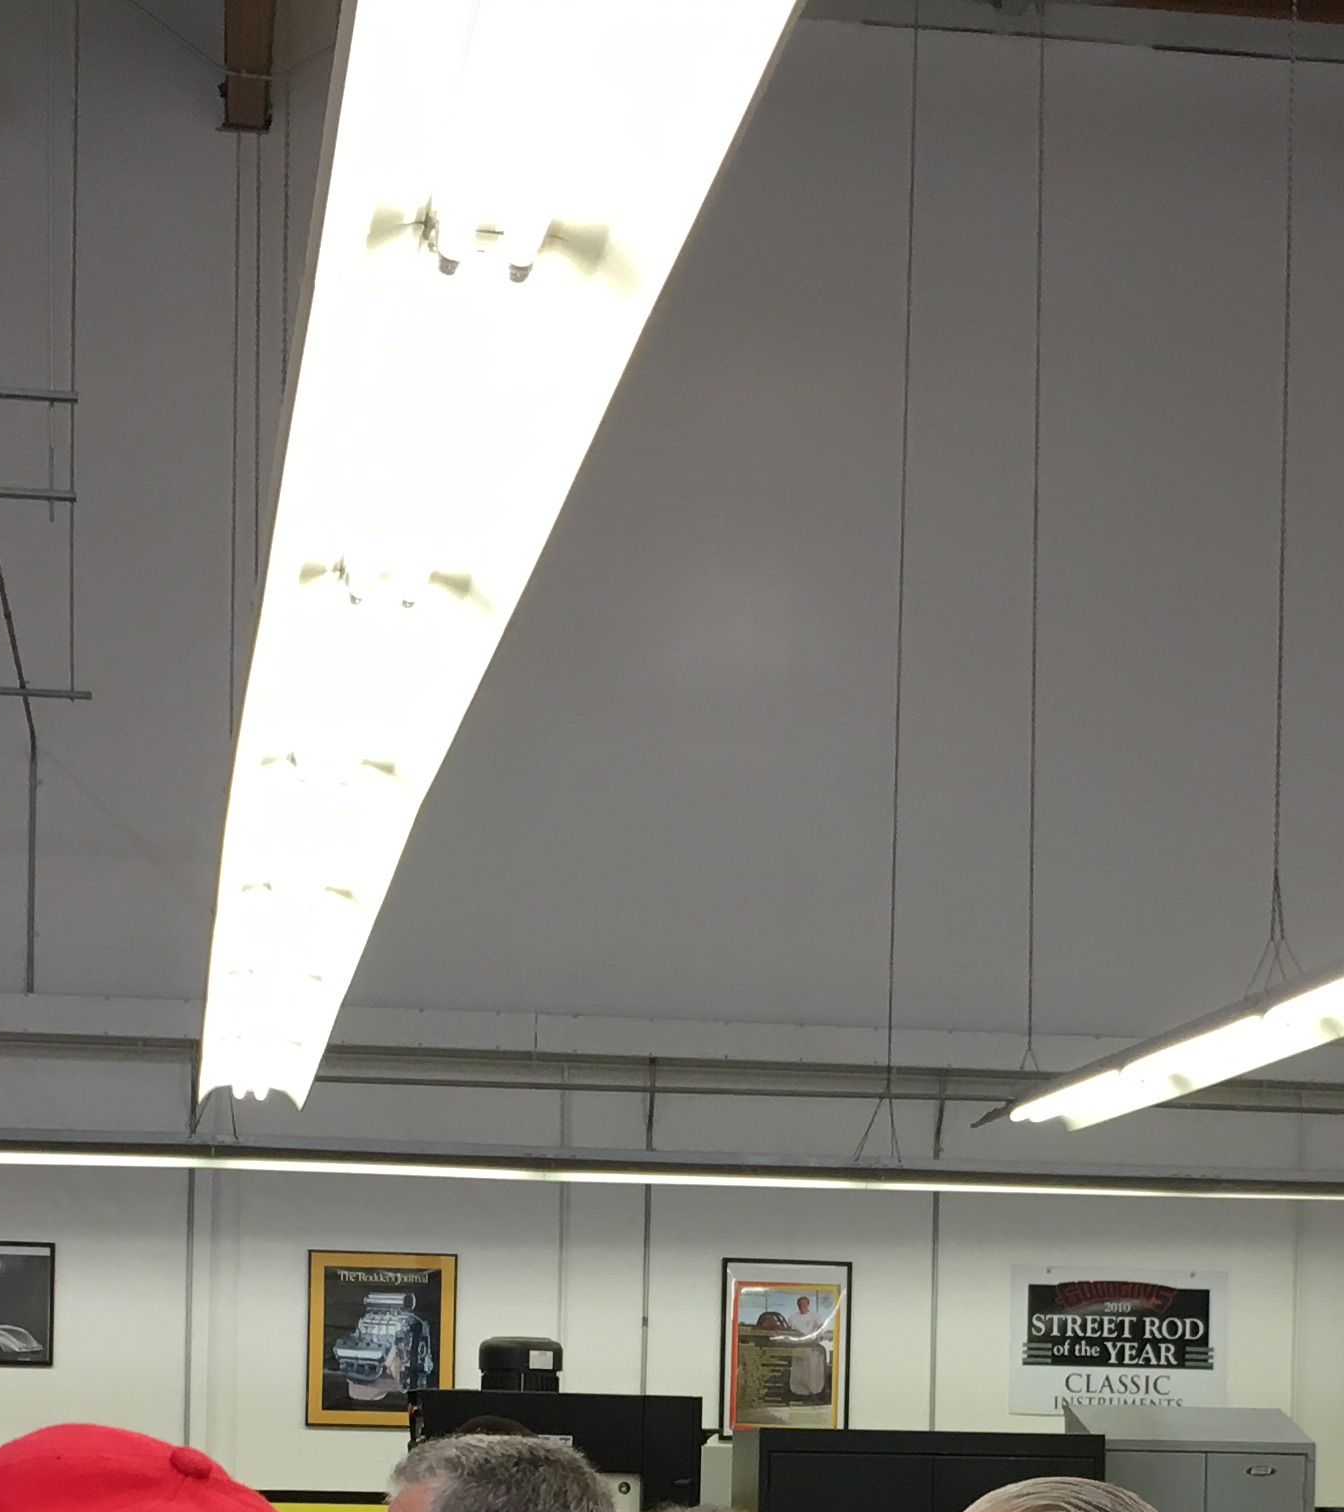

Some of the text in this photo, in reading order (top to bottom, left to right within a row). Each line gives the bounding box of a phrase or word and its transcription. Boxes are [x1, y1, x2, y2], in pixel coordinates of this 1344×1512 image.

[338, 1269, 357, 1282] The
[1104, 1302, 1132, 1313] 2010
[1031, 1313, 1205, 1340] STREET ROD
[1053, 1340, 1179, 1366] of the YEAR
[1064, 1372, 1171, 1396] CLASSIC
